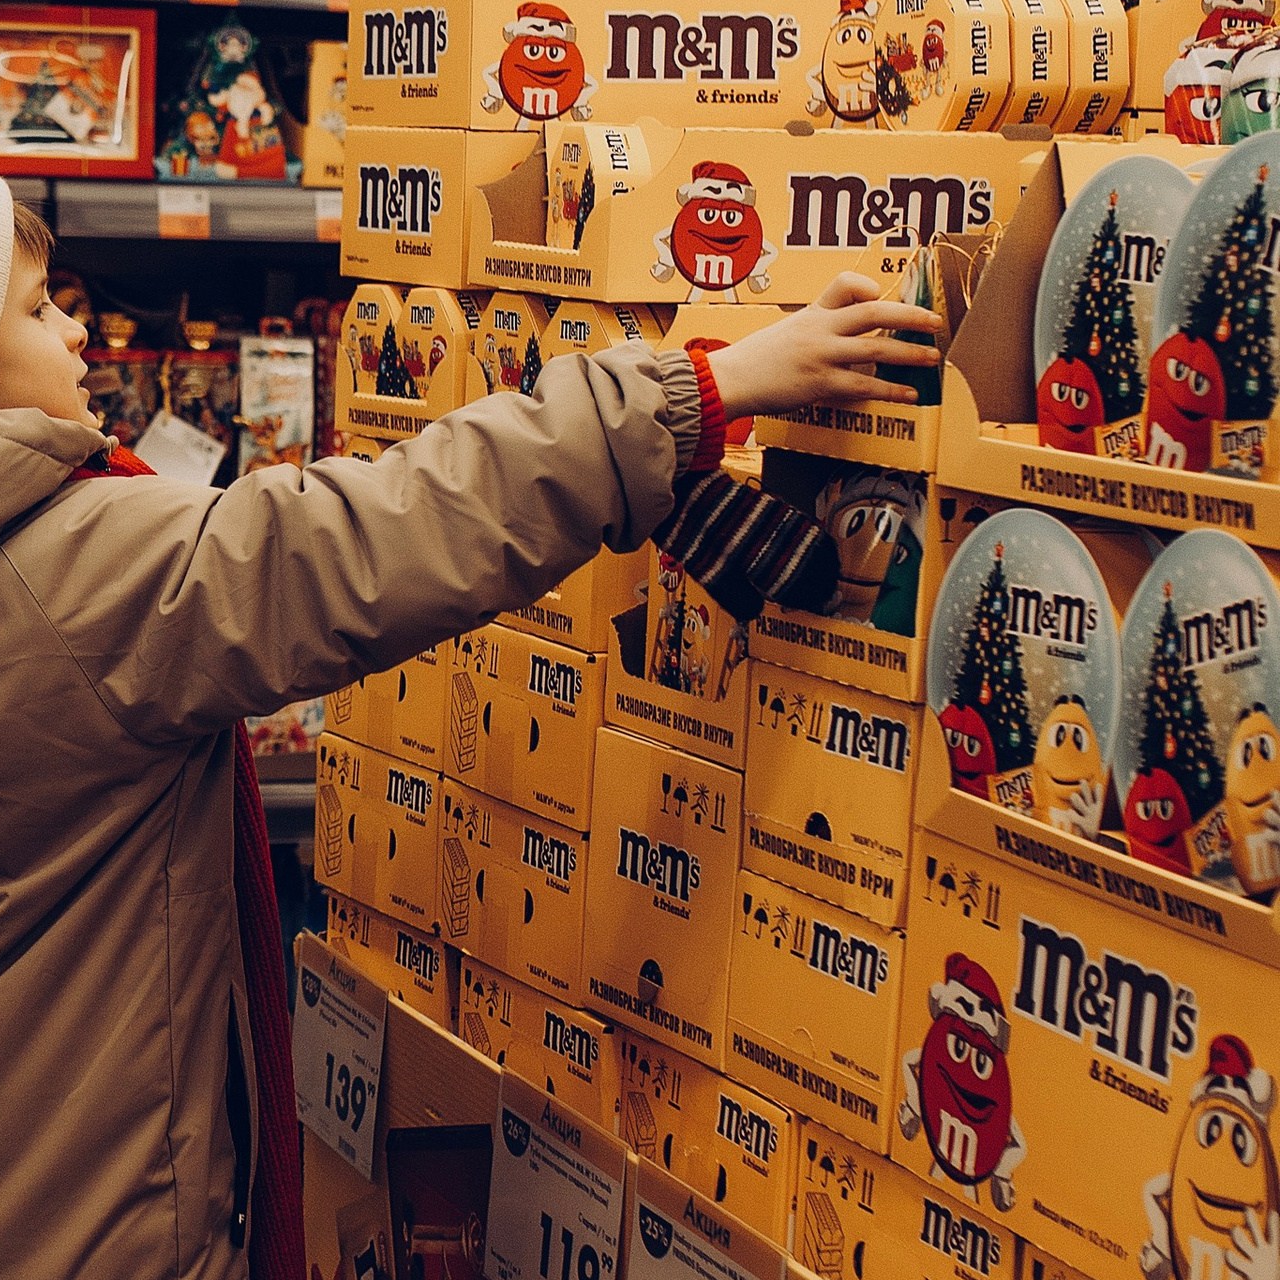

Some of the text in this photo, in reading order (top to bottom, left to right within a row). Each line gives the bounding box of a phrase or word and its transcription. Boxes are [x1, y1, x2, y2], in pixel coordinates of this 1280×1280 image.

[364, 9, 446, 75] m&m's
[607, 14, 797, 79] m&m's
[408, 84, 439, 97] friends
[696, 90, 779, 104] & friends
[358, 167, 441, 233] m&m's
[786, 176, 990, 247] m&m's
[402, 240, 432, 256] friends
[485, 257, 591, 287] РАЗНООБРАЗИЕ ВКУСОВ ВНУТРИ
[876, 415, 915, 441] ВНУТРИ
[547, 610, 572, 634] ВНУТРИ
[1009, 587, 1097, 643] m&m's
[1183, 599, 1267, 667] m&m's
[529, 655, 582, 703] m&m's
[616, 693, 734, 749] РАЗНООБРАЗИЕ ВКУСОВ ВНУТРИ
[387, 770, 432, 814] m&m's
[523, 827, 577, 881] m&m's
[618, 828, 700, 901] m&m's
[818, 853, 855, 884] ВКУСОВ
[659, 898, 690, 920] friends
[810, 921, 888, 994] m&m's
[650, 1005, 679, 1034] ВКУСОВ
[1016, 919, 1195, 1076] m&m's
[544, 1011, 598, 1070] m&m's
[325, 1051, 367, 1133] 139
[733, 1032, 799, 1084] РАЗНООБРАЗИЕ
[803, 1070, 838, 1103] ВКУСОВ
[841, 1089, 878, 1124] ВНУТРИ
[1091, 1060, 1168, 1114] & friends
[503, 1118, 527, 1145] -26%
[541, 1100, 581, 1149] Акция
[718, 1095, 778, 1162] m&m's
[641, 1218, 668, 1246] -25%
[683, 1194, 731, 1250] Акция
[921, 1197, 1000, 1275] m&m's
[601, 1252, 613, 1274] 99
